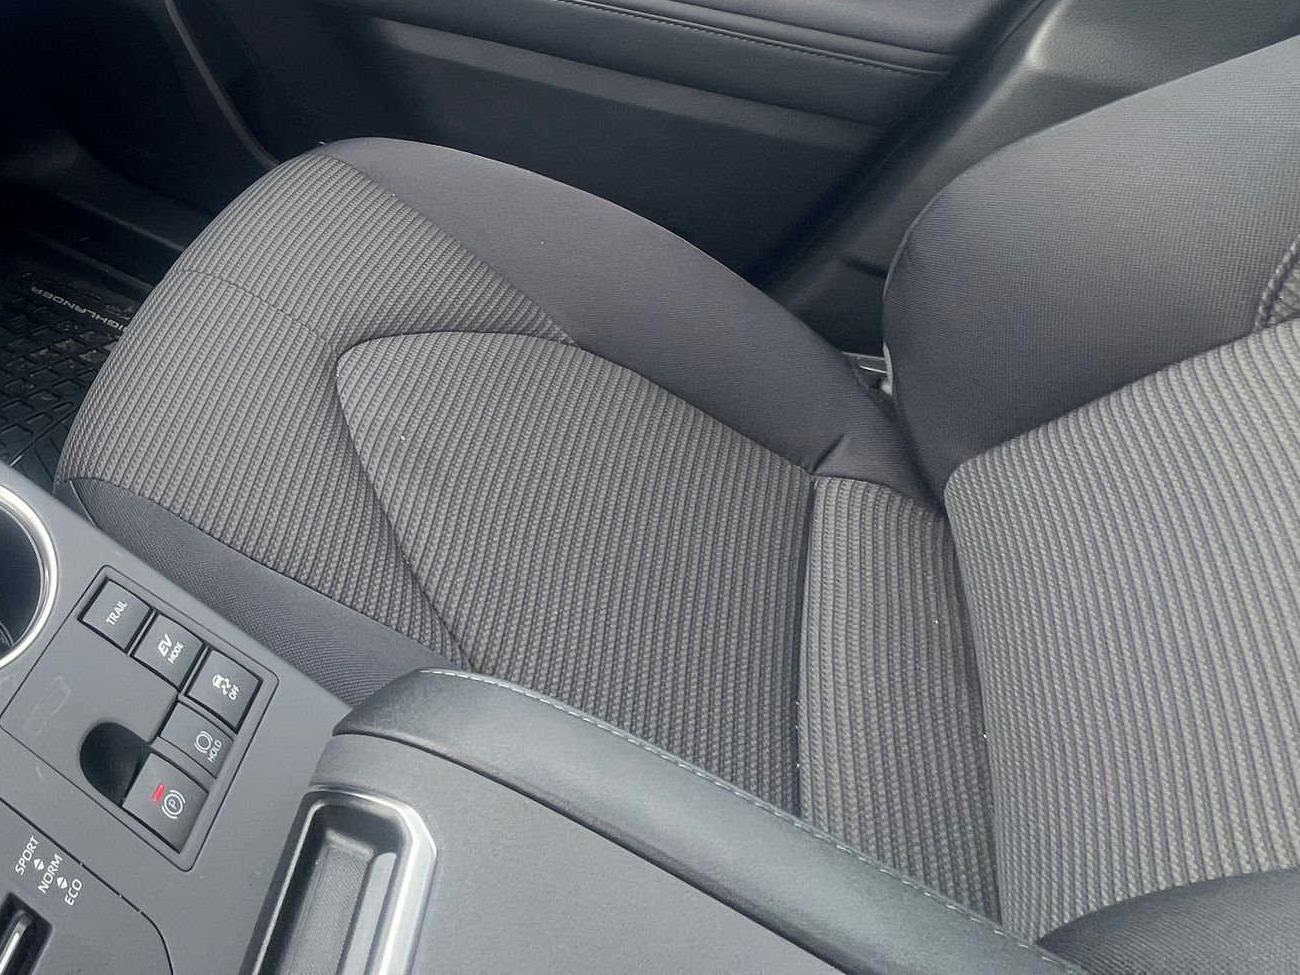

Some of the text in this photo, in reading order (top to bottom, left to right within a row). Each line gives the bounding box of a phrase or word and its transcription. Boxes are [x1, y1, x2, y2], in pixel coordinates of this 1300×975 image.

[106, 600, 128, 627] TRAIL
[157, 633, 174, 658] EV
[168, 641, 184, 665] MODE
[229, 685, 242, 701] OFF
[207, 739, 223, 764] HOLD
[15, 835, 39, 876] SPORT
[37, 853, 63, 894] NORM
[64, 878, 83, 906] ECO
